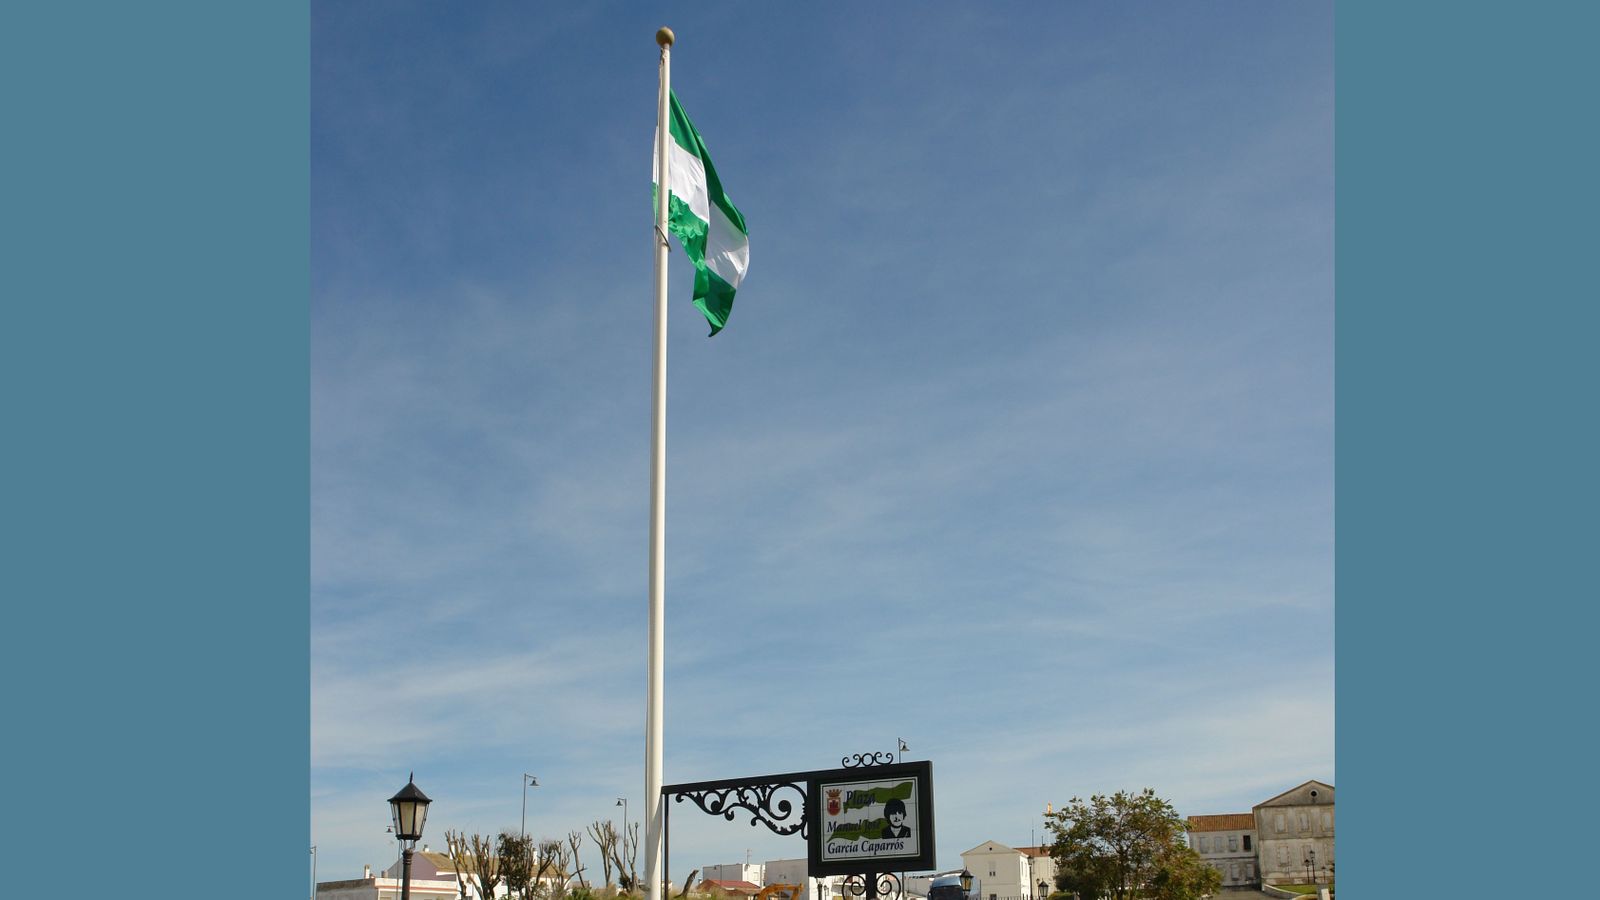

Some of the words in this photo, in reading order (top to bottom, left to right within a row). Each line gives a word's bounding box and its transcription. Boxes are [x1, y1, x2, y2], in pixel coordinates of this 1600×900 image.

[846, 790, 875, 805] Plaza
[827, 819, 862, 833] Manuel
[828, 841, 859, 854] García
[861, 839, 904, 855] Caparrós
